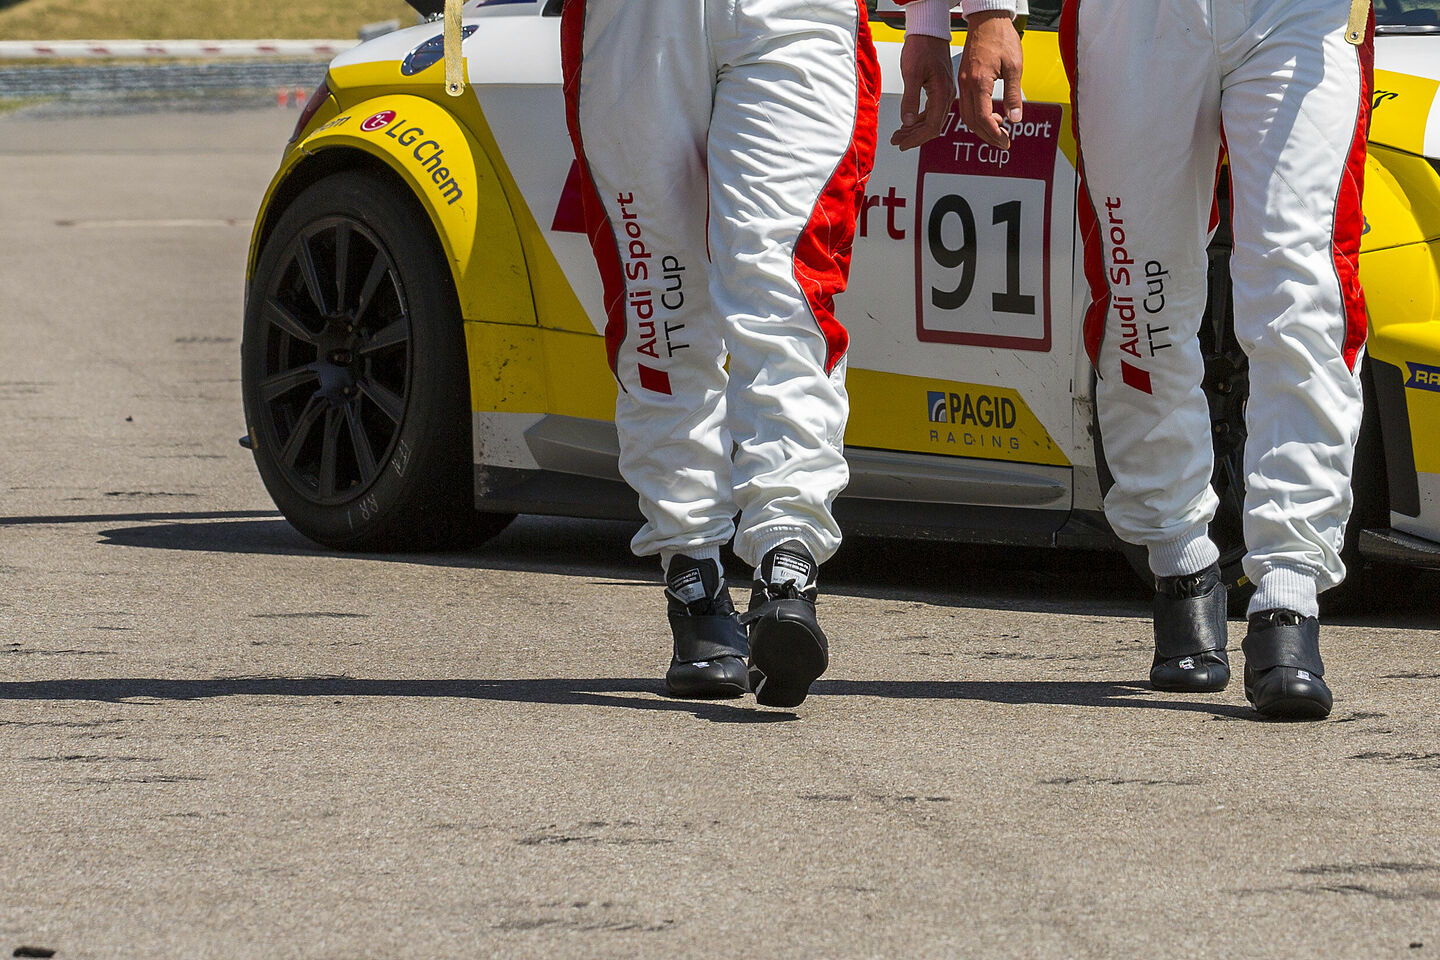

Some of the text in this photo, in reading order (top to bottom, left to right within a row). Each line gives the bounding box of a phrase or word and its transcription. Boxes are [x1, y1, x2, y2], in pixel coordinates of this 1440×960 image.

[384, 119, 464, 205] LG Chem
[952, 142, 1010, 168] TT Cup
[617, 192, 660, 358] Audi Sport
[927, 193, 1036, 315] 91
[1105, 196, 1142, 358] Audi Sport
[661, 255, 690, 357] TT Cup
[1143, 260, 1172, 357] TT Cup
[929, 429, 1020, 450] RACING
[949, 392, 1017, 429] PAGID
